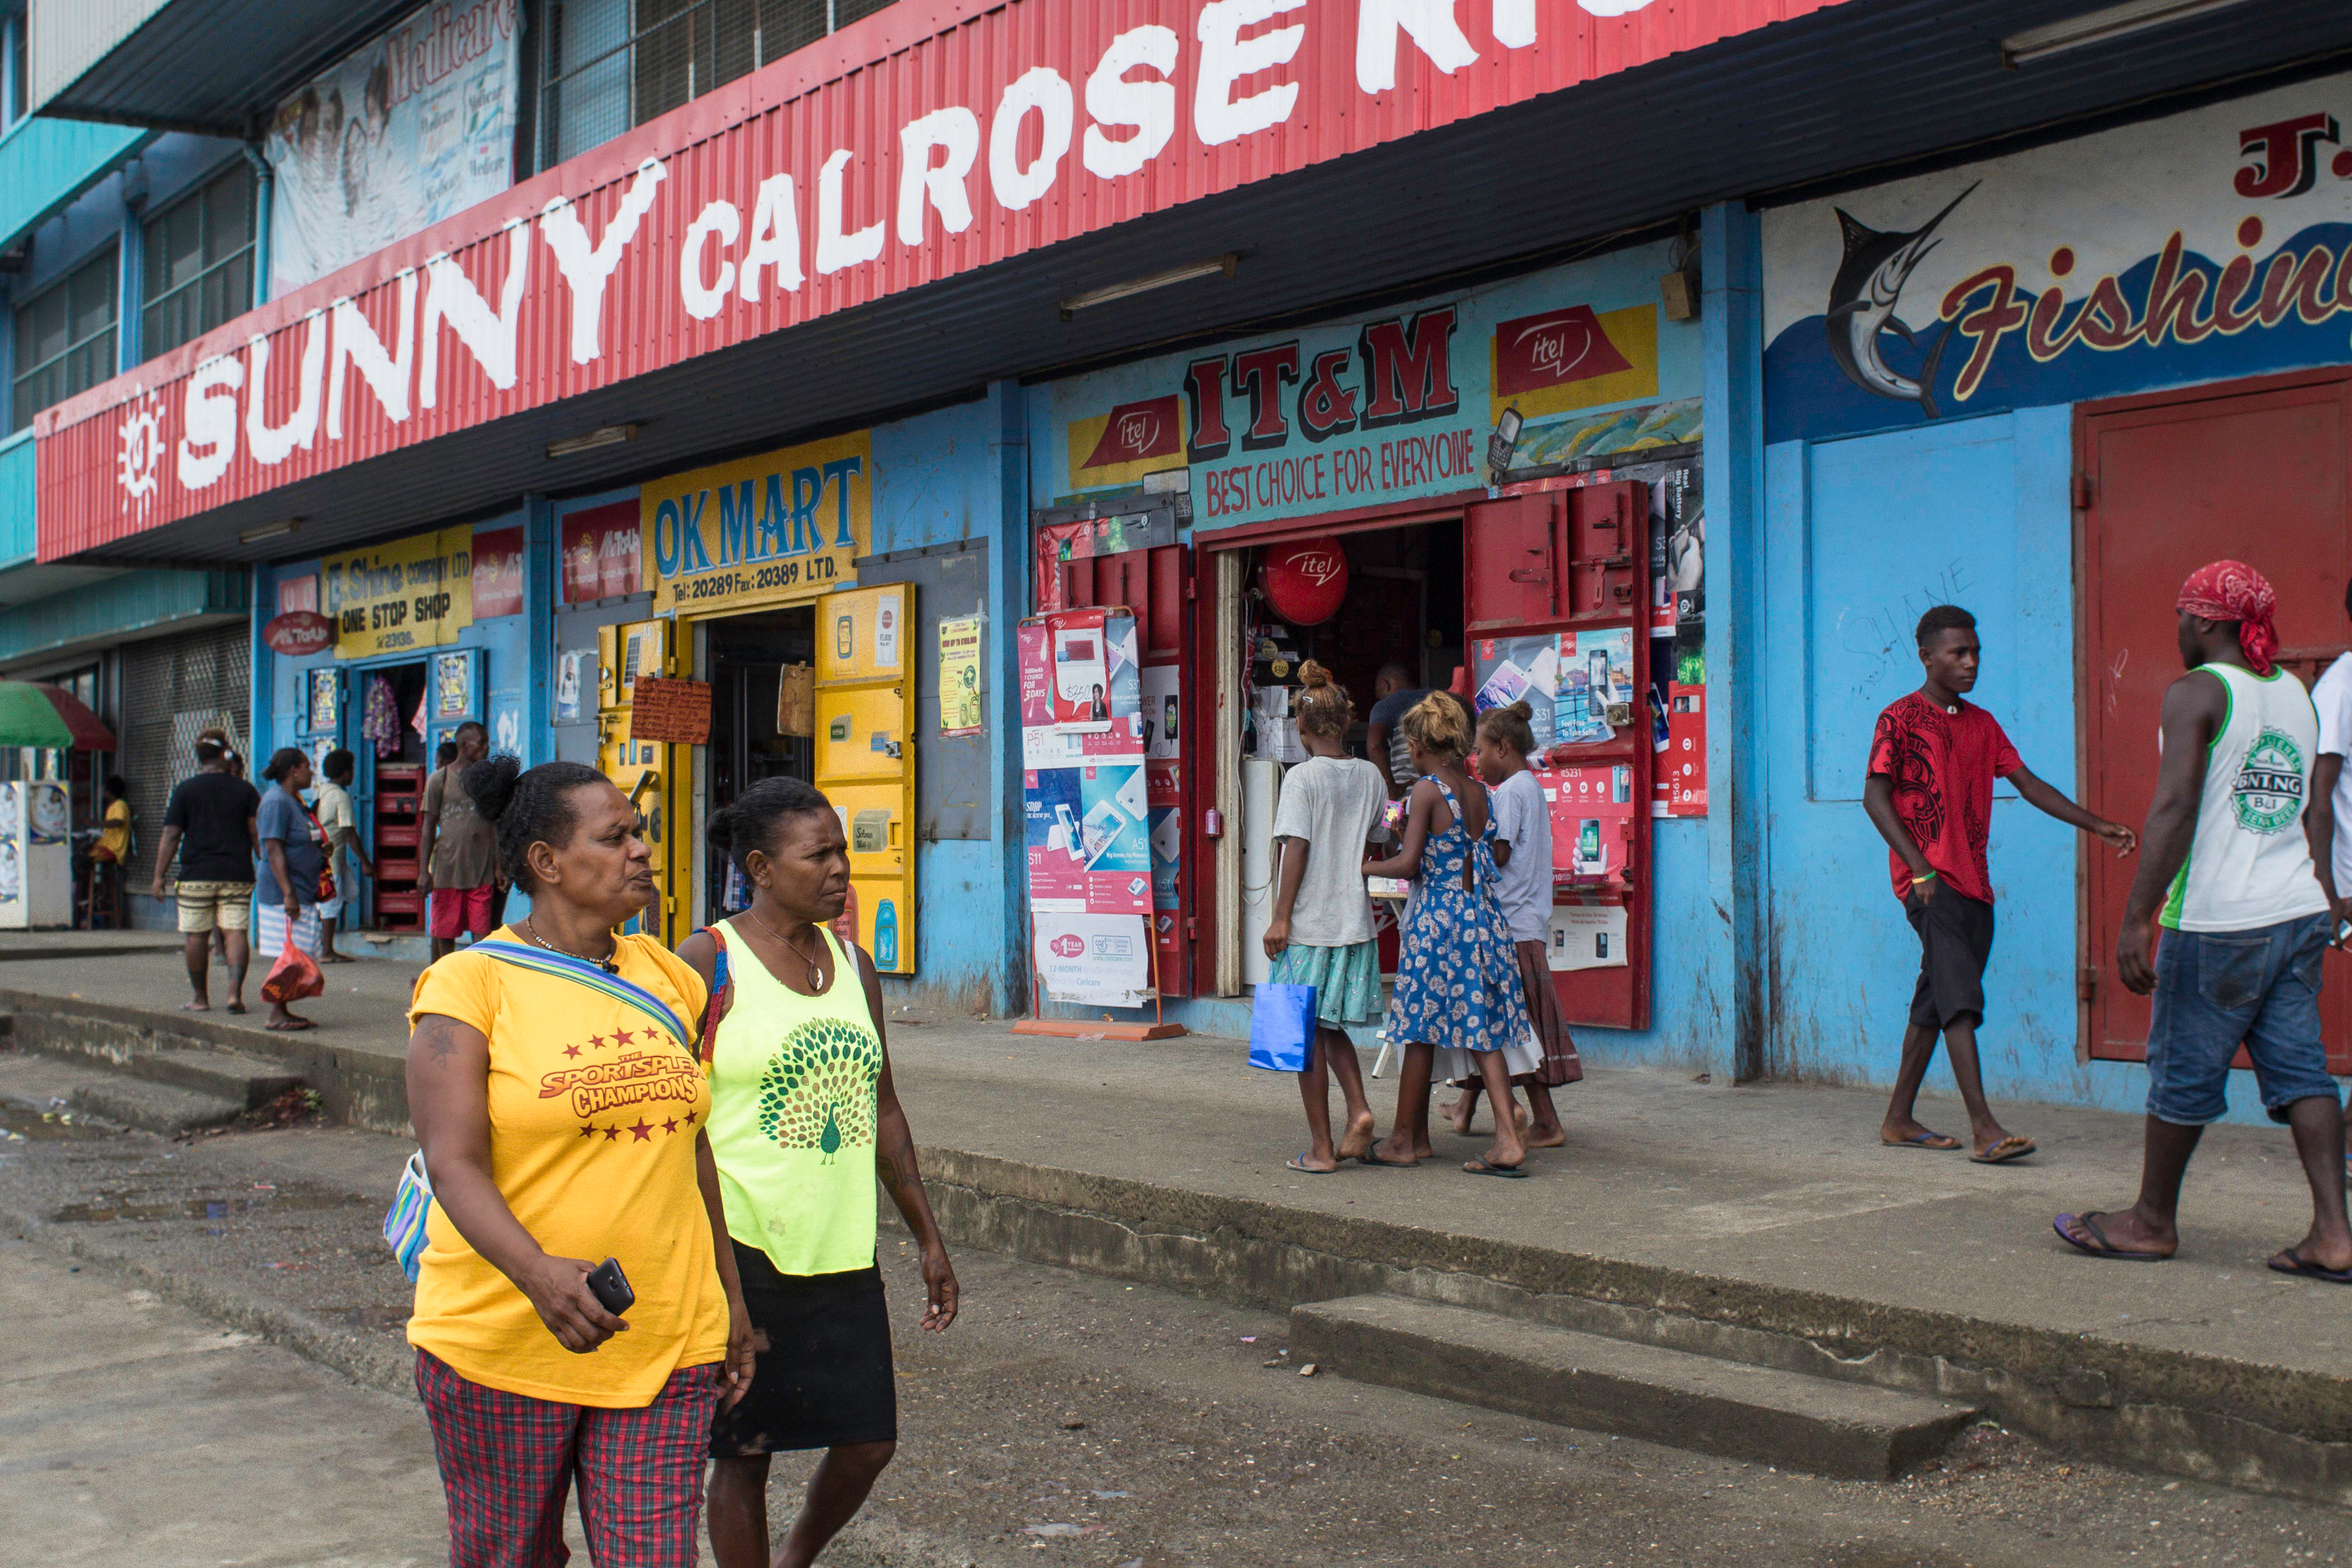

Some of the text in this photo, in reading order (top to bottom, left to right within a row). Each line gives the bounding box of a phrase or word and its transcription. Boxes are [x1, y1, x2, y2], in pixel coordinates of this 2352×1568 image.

[178, 0, 1305, 490] SUNNY CALROSE
[1184, 304, 1459, 463] IT&M
[1205, 427, 1474, 517] BEST CHOICE FOR EVERYONE
[654, 455, 864, 579] OK MART
[692, 574, 733, 598] 20289
[757, 563, 798, 589] 20389
[806, 556, 837, 581] LTD.
[343, 607, 366, 634] ONE
[372, 600, 407, 630] STOP
[415, 592, 450, 622] SHOP
[1024, 681, 1035, 690] FOR
[1024, 689, 1045, 702] 3 DAYS
[1535, 708, 1551, 721] S31
[1027, 732, 1044, 747] P51
[1561, 768, 1582, 778] it5231
[1131, 838, 1147, 850] A51
[1028, 852, 1042, 865] S11
[1061, 938, 1068, 954] 1
[1049, 965, 1082, 973] 12-MONTH
[1076, 978, 1100, 987] Carlcare
[618, 1051, 642, 1062] THE
[572, 1073, 698, 1119] CHAMPIONS
